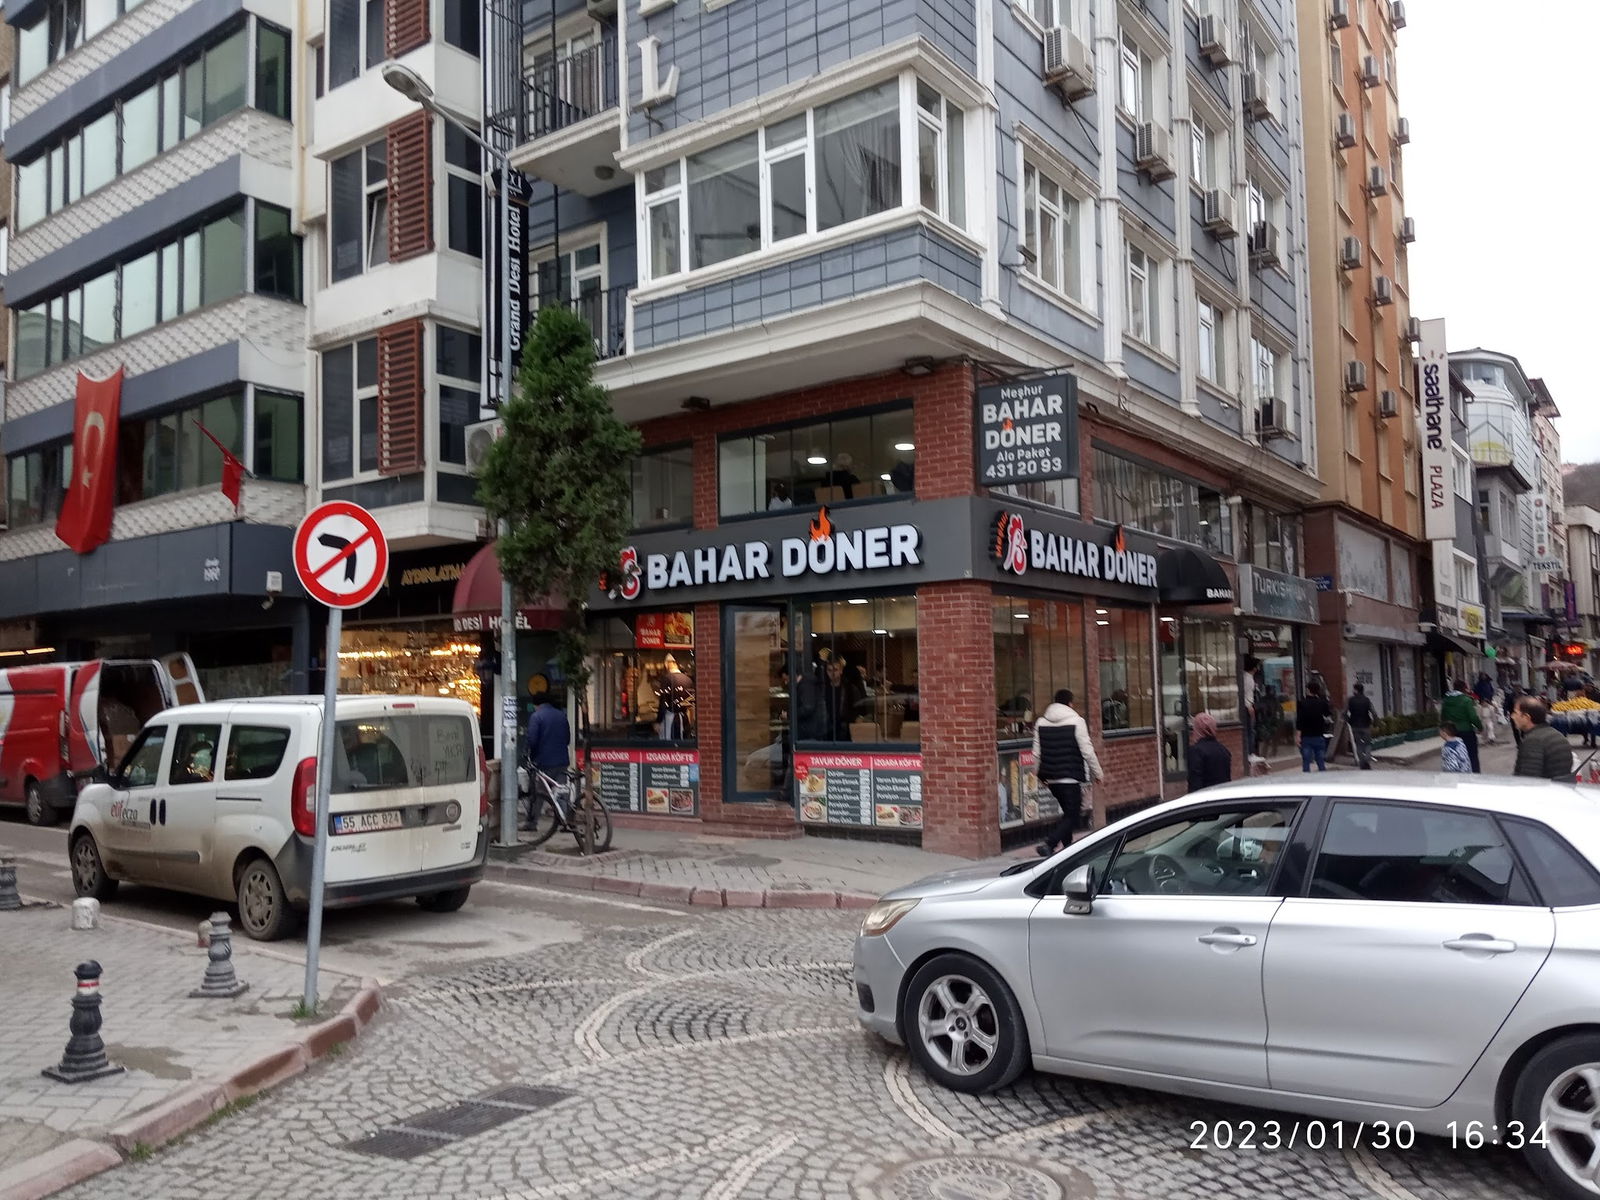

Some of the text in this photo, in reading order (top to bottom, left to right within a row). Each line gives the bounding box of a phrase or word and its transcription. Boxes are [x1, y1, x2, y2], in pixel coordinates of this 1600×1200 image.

[1001, 384, 1043, 400] Meşhur
[1424, 363, 1442, 450] saathane
[983, 394, 1063, 424] BAHAR
[986, 457, 1062, 478] 431 20 93
[996, 446, 1051, 463] Alo Paket
[1430, 465, 1443, 510] PLAZA
[647, 540, 770, 590] BAHAR
[1029, 529, 1100, 579] BAHAR
[343, 813, 399, 829] 55 ACC 824
